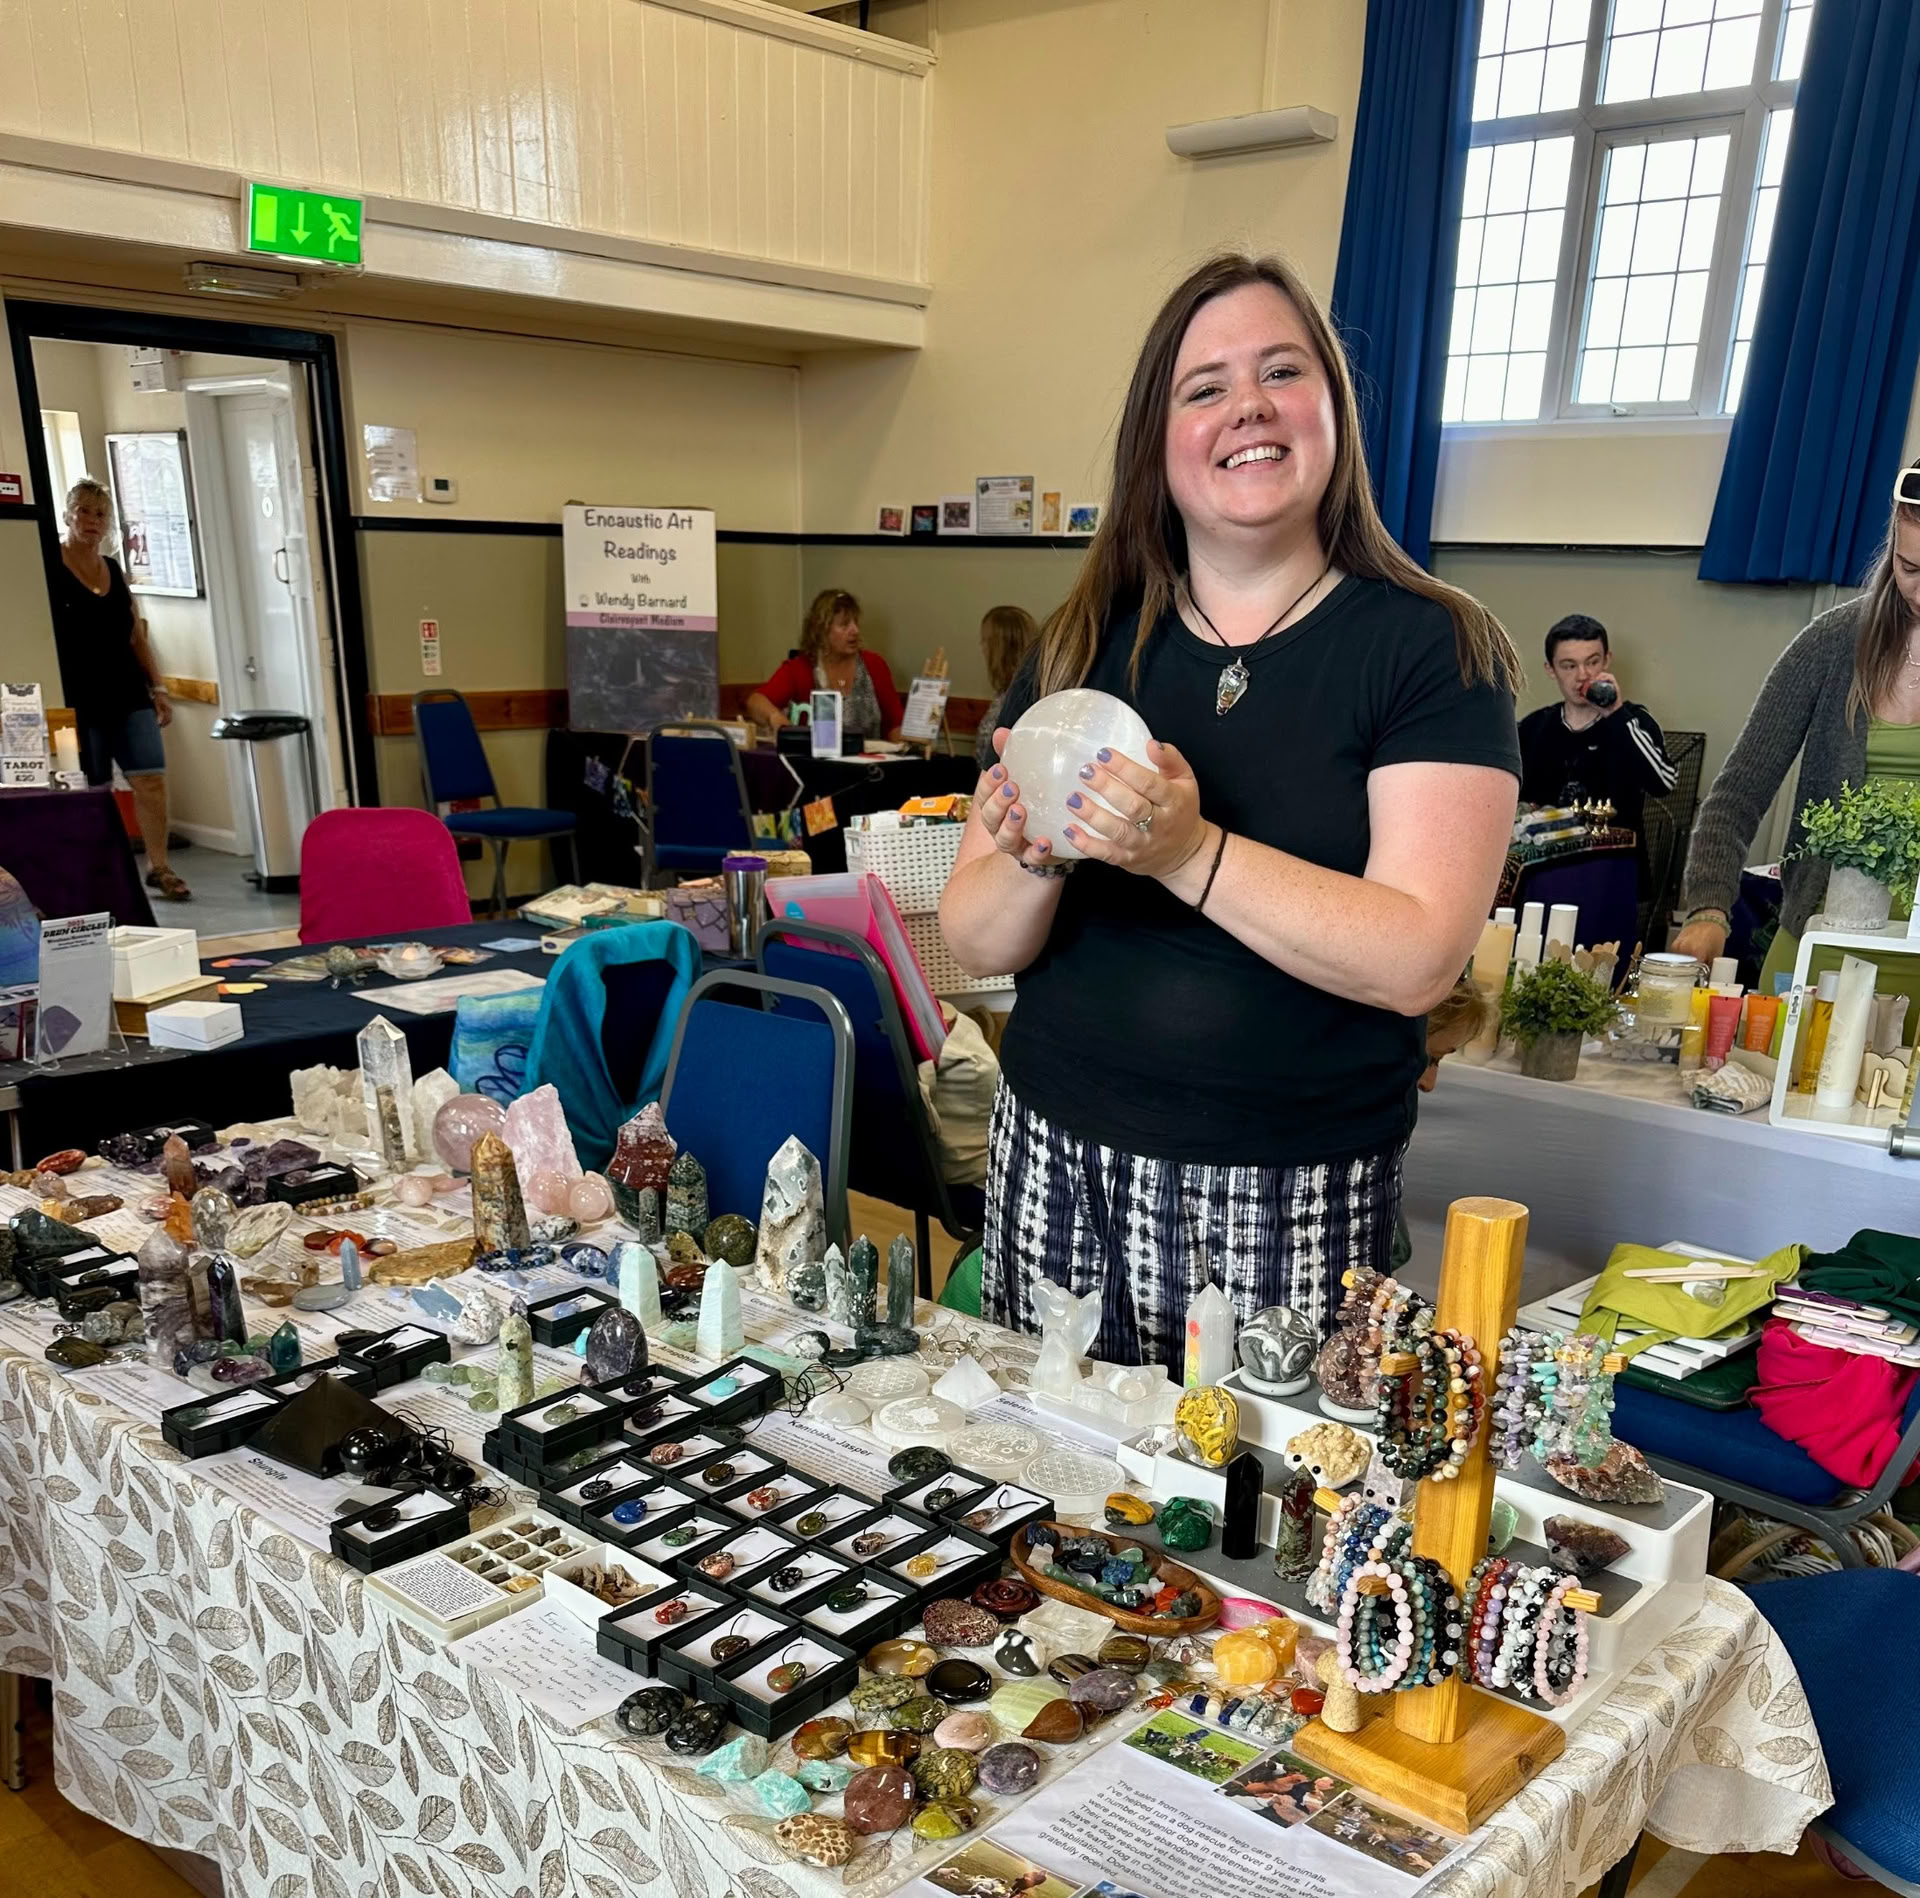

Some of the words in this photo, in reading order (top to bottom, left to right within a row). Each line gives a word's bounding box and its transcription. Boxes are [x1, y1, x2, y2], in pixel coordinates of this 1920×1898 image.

[584, 508, 663, 529] Encaustic
[666, 513, 693, 530] Art
[604, 540, 677, 565] Readings
[630, 573, 651, 584] With
[595, 592, 635, 610] Wendy
[637, 593, 687, 608] Barnard
[651, 615, 684, 626] Medium
[4, 761, 44, 770] TAROT
[15, 774, 35, 783] £20
[43, 928, 70, 938] DRUM
[70, 922, 107, 934] CIRCLES
[750, 1298, 776, 1310] Green
[800, 1315, 826, 1328] Agate
[996, 1397, 1038, 1416] Selenite
[788, 1420, 836, 1442] Kambaba
[836, 1440, 874, 1457] Jasper
[248, 1457, 288, 1481] Shungite
[1117, 1779, 1132, 1791] The
[1133, 1790, 1156, 1802] sales
[1157, 1800, 1177, 1812] from
[1178, 1811, 1193, 1820] my
[1193, 1819, 1227, 1837] crystals
[1228, 1835, 1249, 1848] help
[1250, 1847, 1272, 1858] care
[1272, 1856, 1288, 1866] for
[1038, 1831, 1078, 1855] gratefully
[1058, 1817, 1077, 1828] and
[1084, 1831, 1113, 1849] fearful
[1112, 1849, 1130, 1860] dog
[1141, 1863, 1168, 1880] China
[1169, 1879, 1187, 1890] due
[1068, 1810, 1090, 1824] have
[1098, 1828, 1116, 1840] dog
[1116, 1839, 1153, 1859] rescued
[1152, 1857, 1174, 1871] from
[1175, 1869, 1190, 1880] the
[1191, 1877, 1230, 1896] Chinese
[1079, 1803, 1101, 1819] Their
[1101, 1818, 1133, 1837] upkeep
[1134, 1836, 1153, 1847] and
[1153, 1846, 1168, 1856] vet
[1167, 1853, 1186, 1866] bills
[1200, 1871, 1226, 1885] come
[1088, 1798, 1109, 1812] were
[1108, 1811, 1153, 1836] previously
[1207, 1863, 1255, 1885] neglected
[1254, 1884, 1275, 1893] and
[1104, 1797, 1138, 1815] number
[1148, 1820, 1176, 1835] senior
[1176, 1834, 1199, 1847] dogs
[1199, 1844, 1209, 1853] in
[1210, 1851, 1258, 1876] retirement
[1259, 1874, 1279, 1885] with
[1279, 1883, 1296, 1892] me
[1122, 1795, 1153, 1812] helped
[1152, 1810, 1168, 1820] run
[1176, 1821, 1194, 1833] dog
[1194, 1830, 1226, 1848] rescue
[1227, 1845, 1241, 1855] for
[1241, 1854, 1264, 1866] over
[1310, 1884, 1336, 1896] have
[1106, 1856, 1151, 1883] Donations
